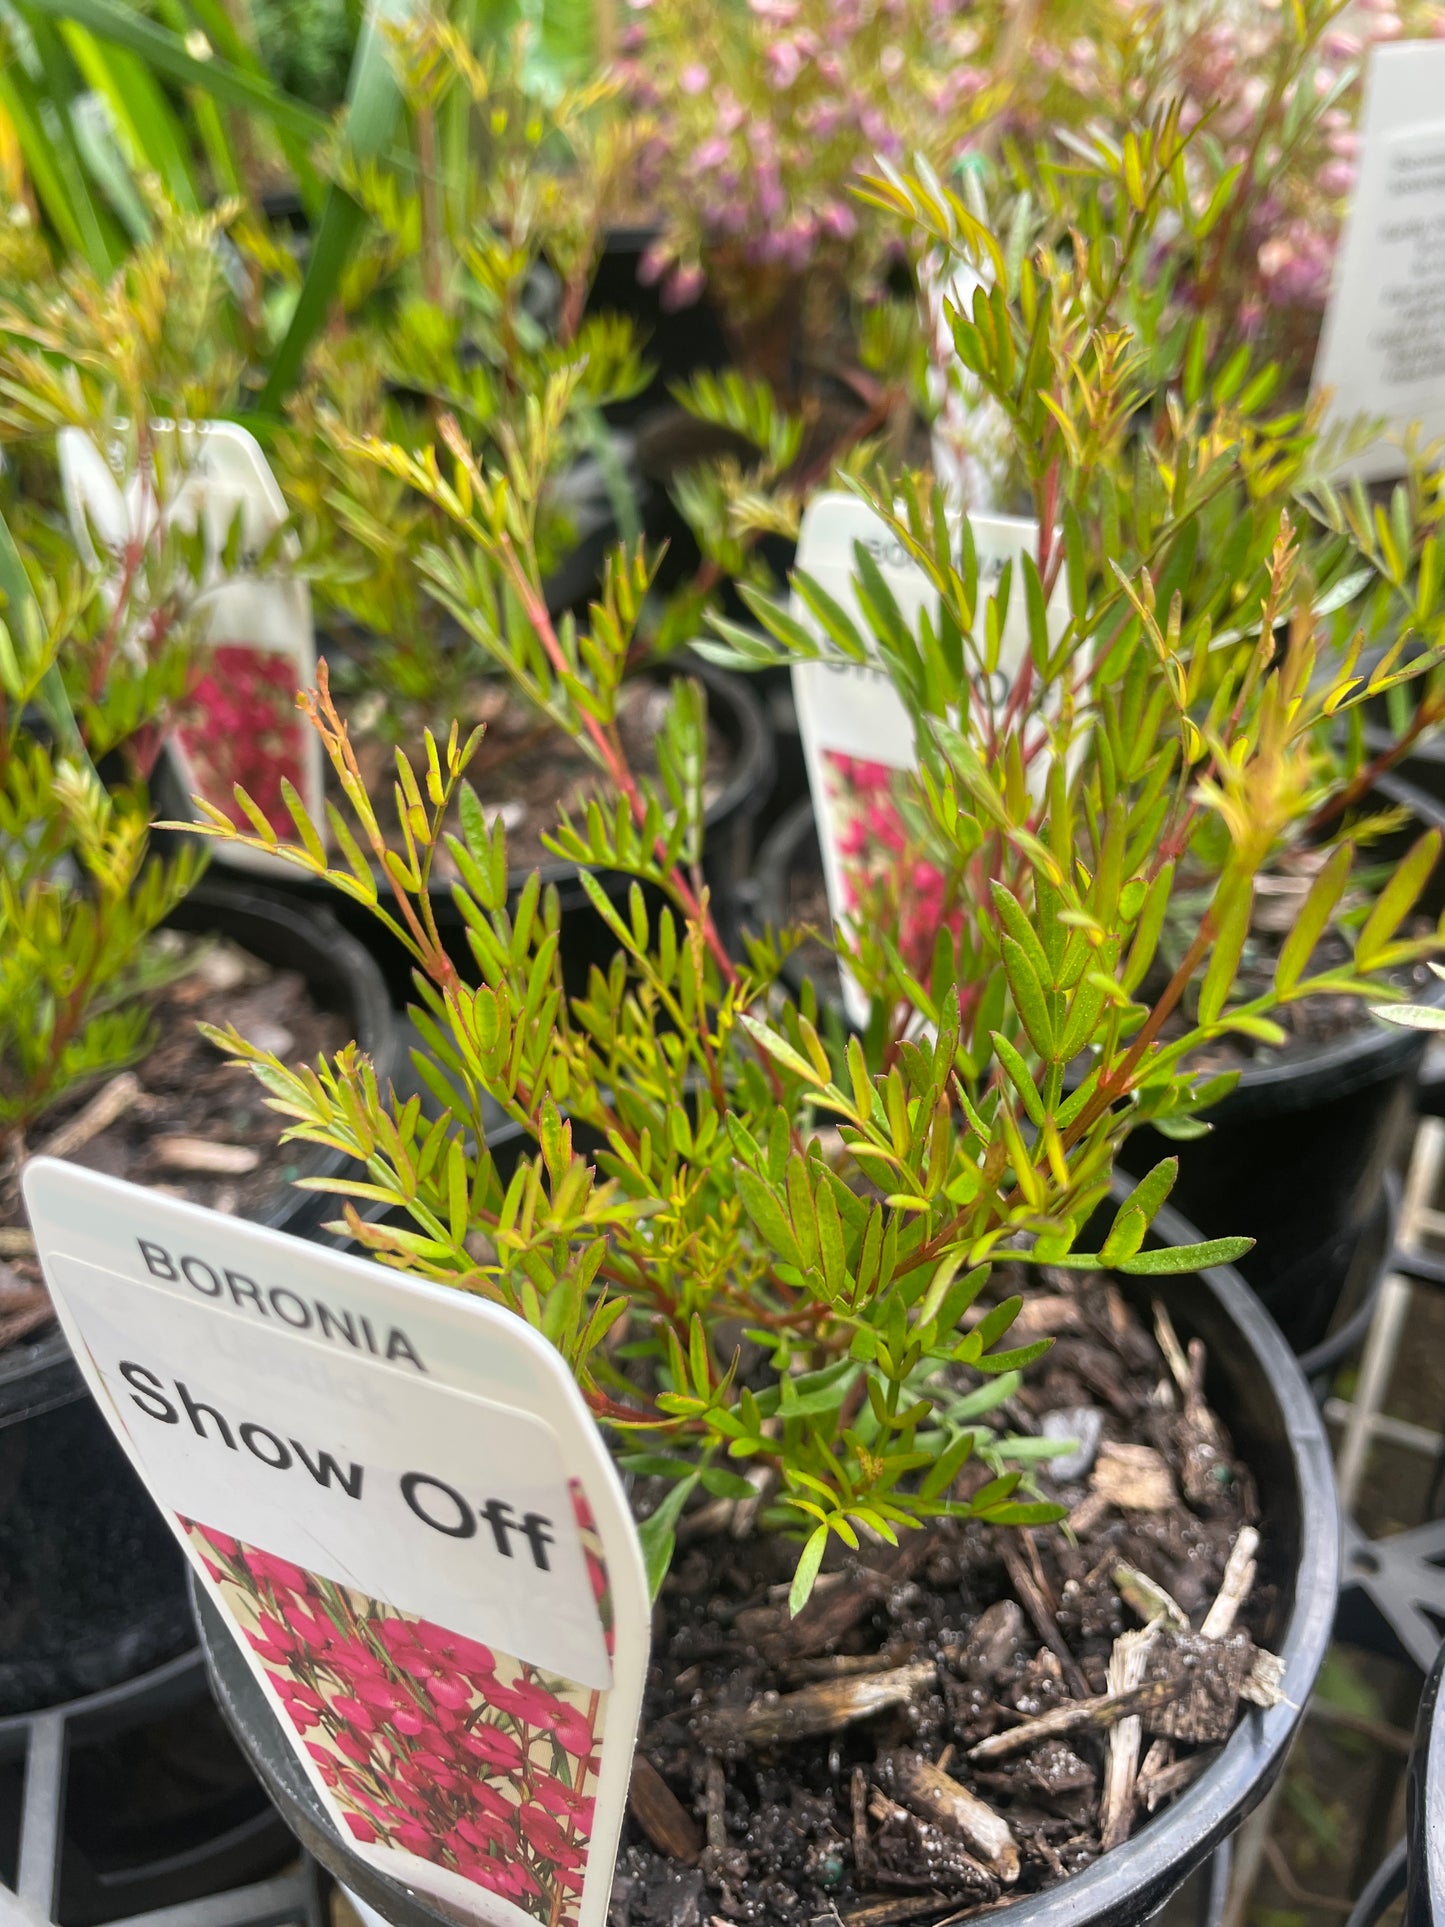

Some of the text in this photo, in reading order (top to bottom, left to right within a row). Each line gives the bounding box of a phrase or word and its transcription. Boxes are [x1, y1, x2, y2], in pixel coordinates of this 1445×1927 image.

[137, 1238, 427, 1373] BORONIA
[118, 1360, 364, 1500] Show
[400, 1472, 555, 1572] Off
